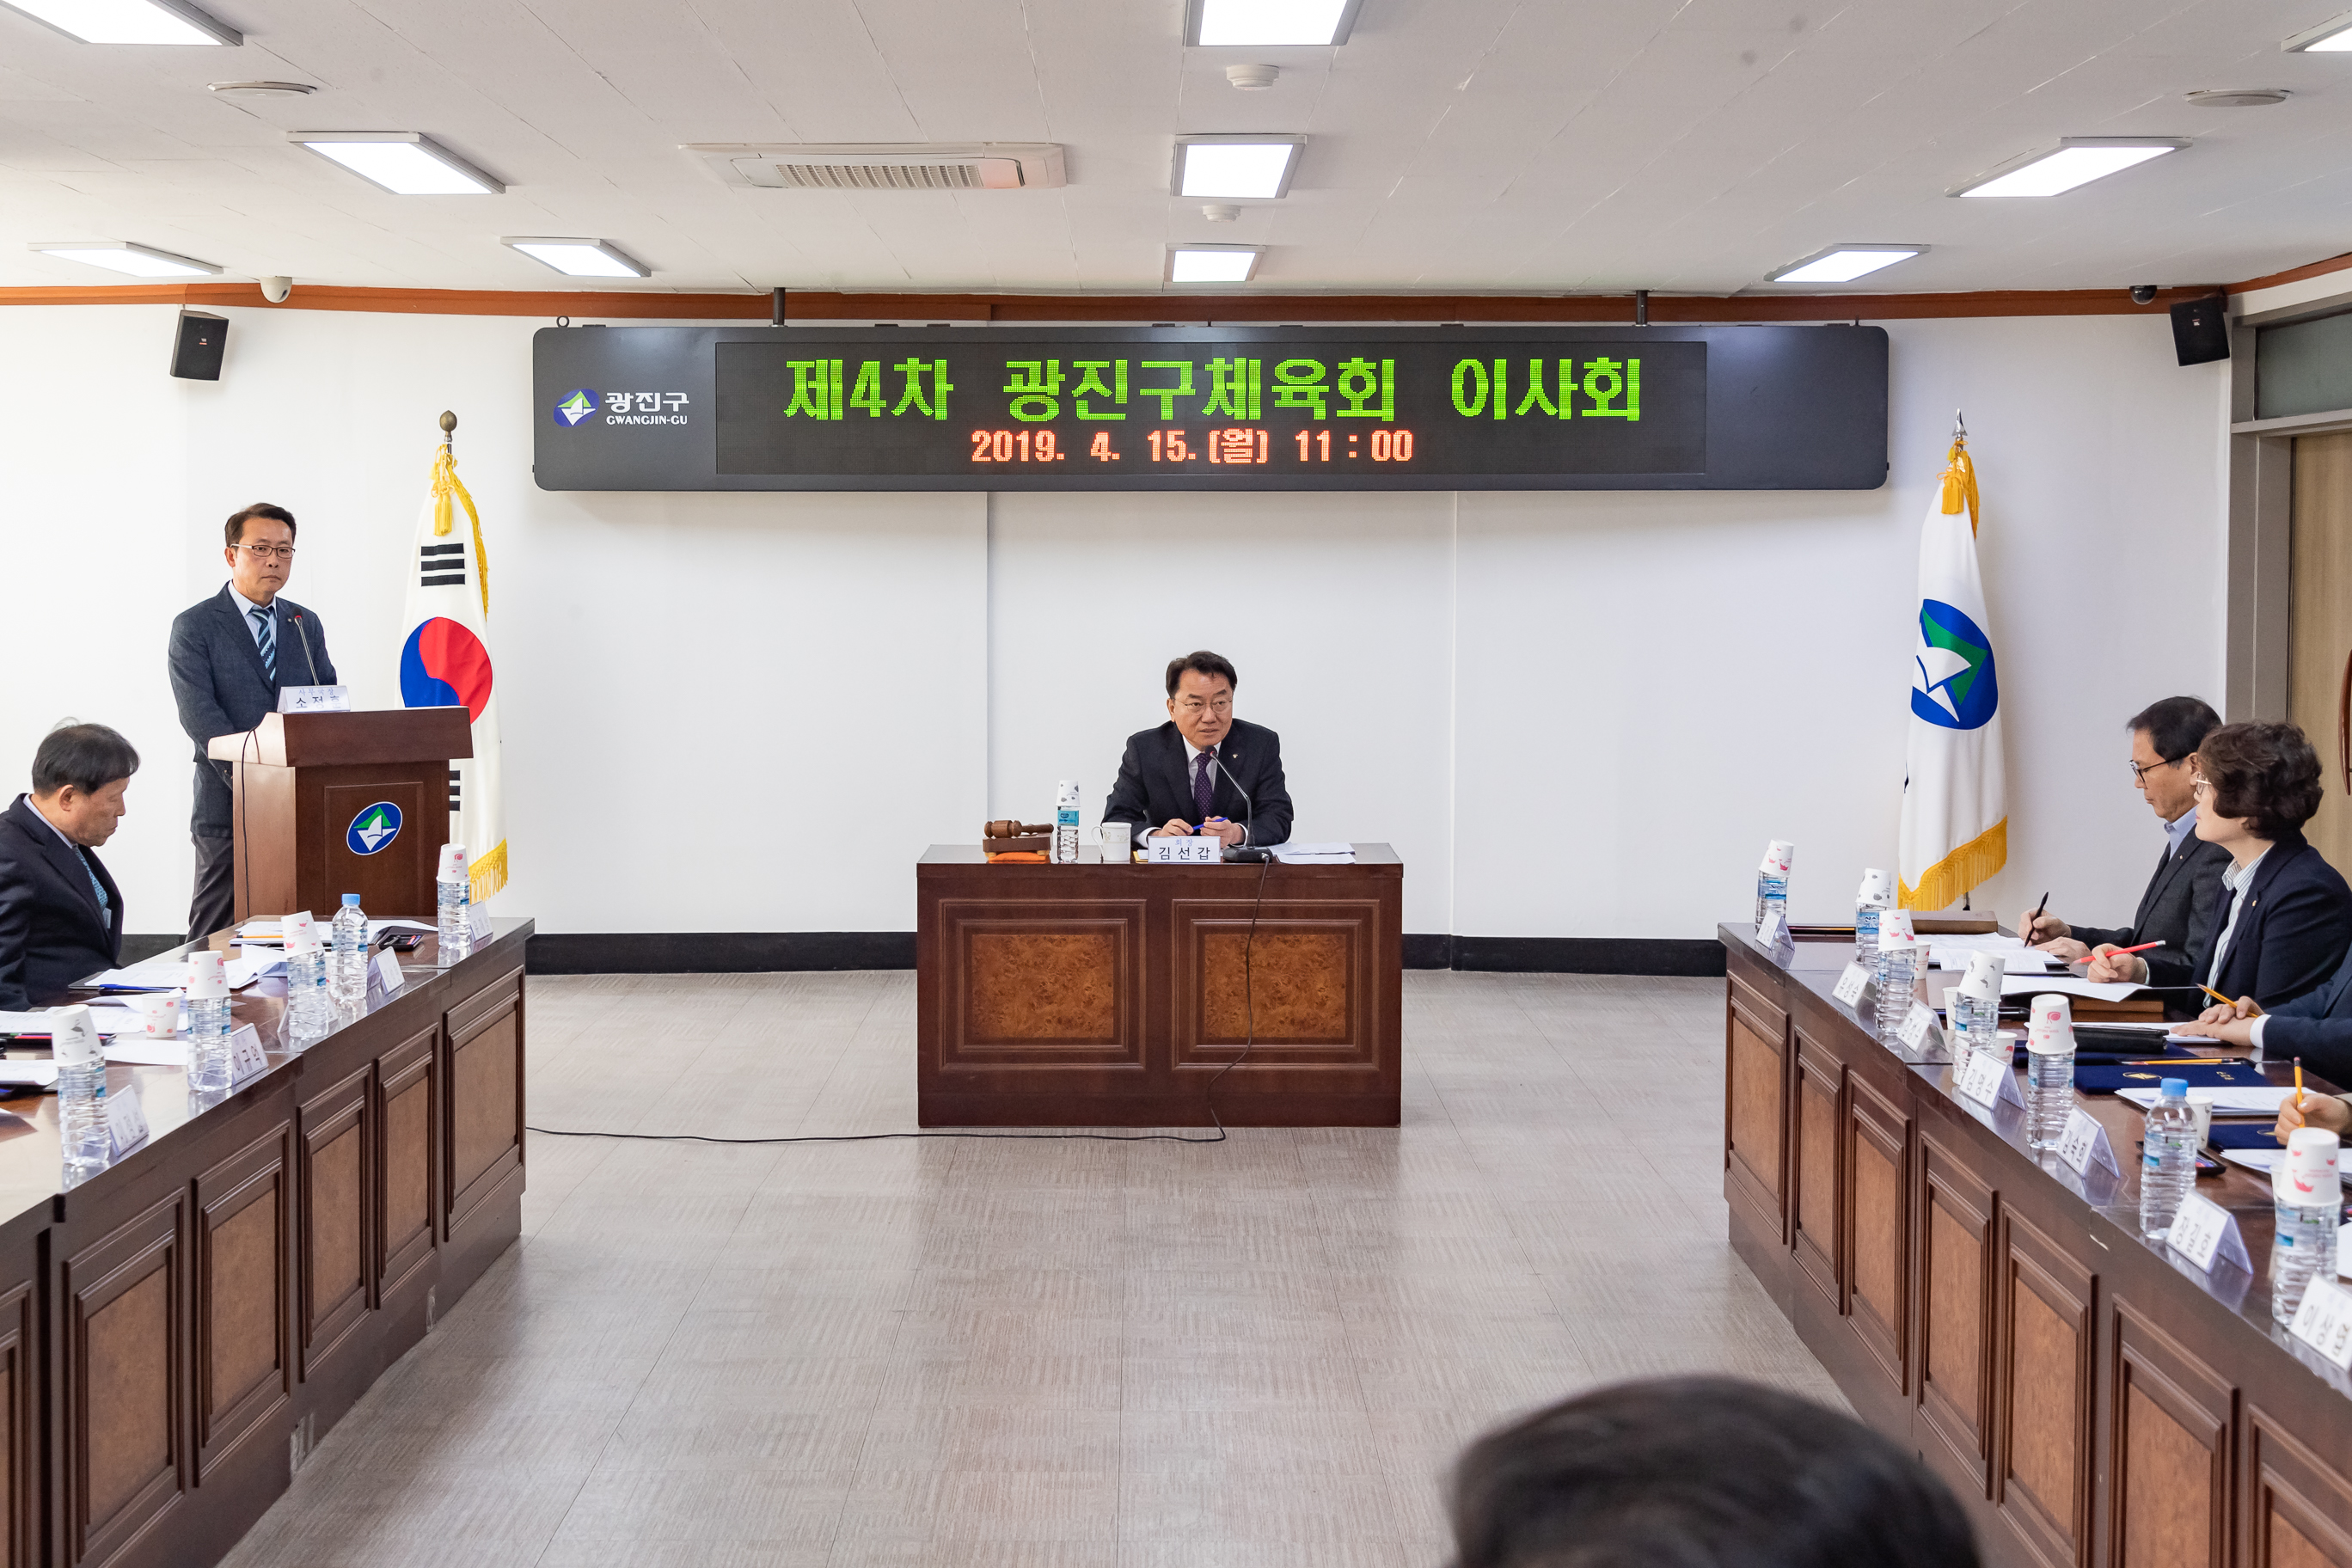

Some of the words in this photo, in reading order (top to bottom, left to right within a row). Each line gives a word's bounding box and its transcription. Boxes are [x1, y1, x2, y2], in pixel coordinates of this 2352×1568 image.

[783, 358, 953, 421] 제4차
[1003, 357, 1395, 422] 광진구체육회
[1452, 357, 1641, 421] 이사회
[605, 392, 689, 413] 광진구
[606, 415, 688, 426] GWANGJIN-GU
[971, 430, 1065, 462] 2019.
[1091, 431, 1121, 462] 4.
[1159, 847, 1211, 861] 김선갑
